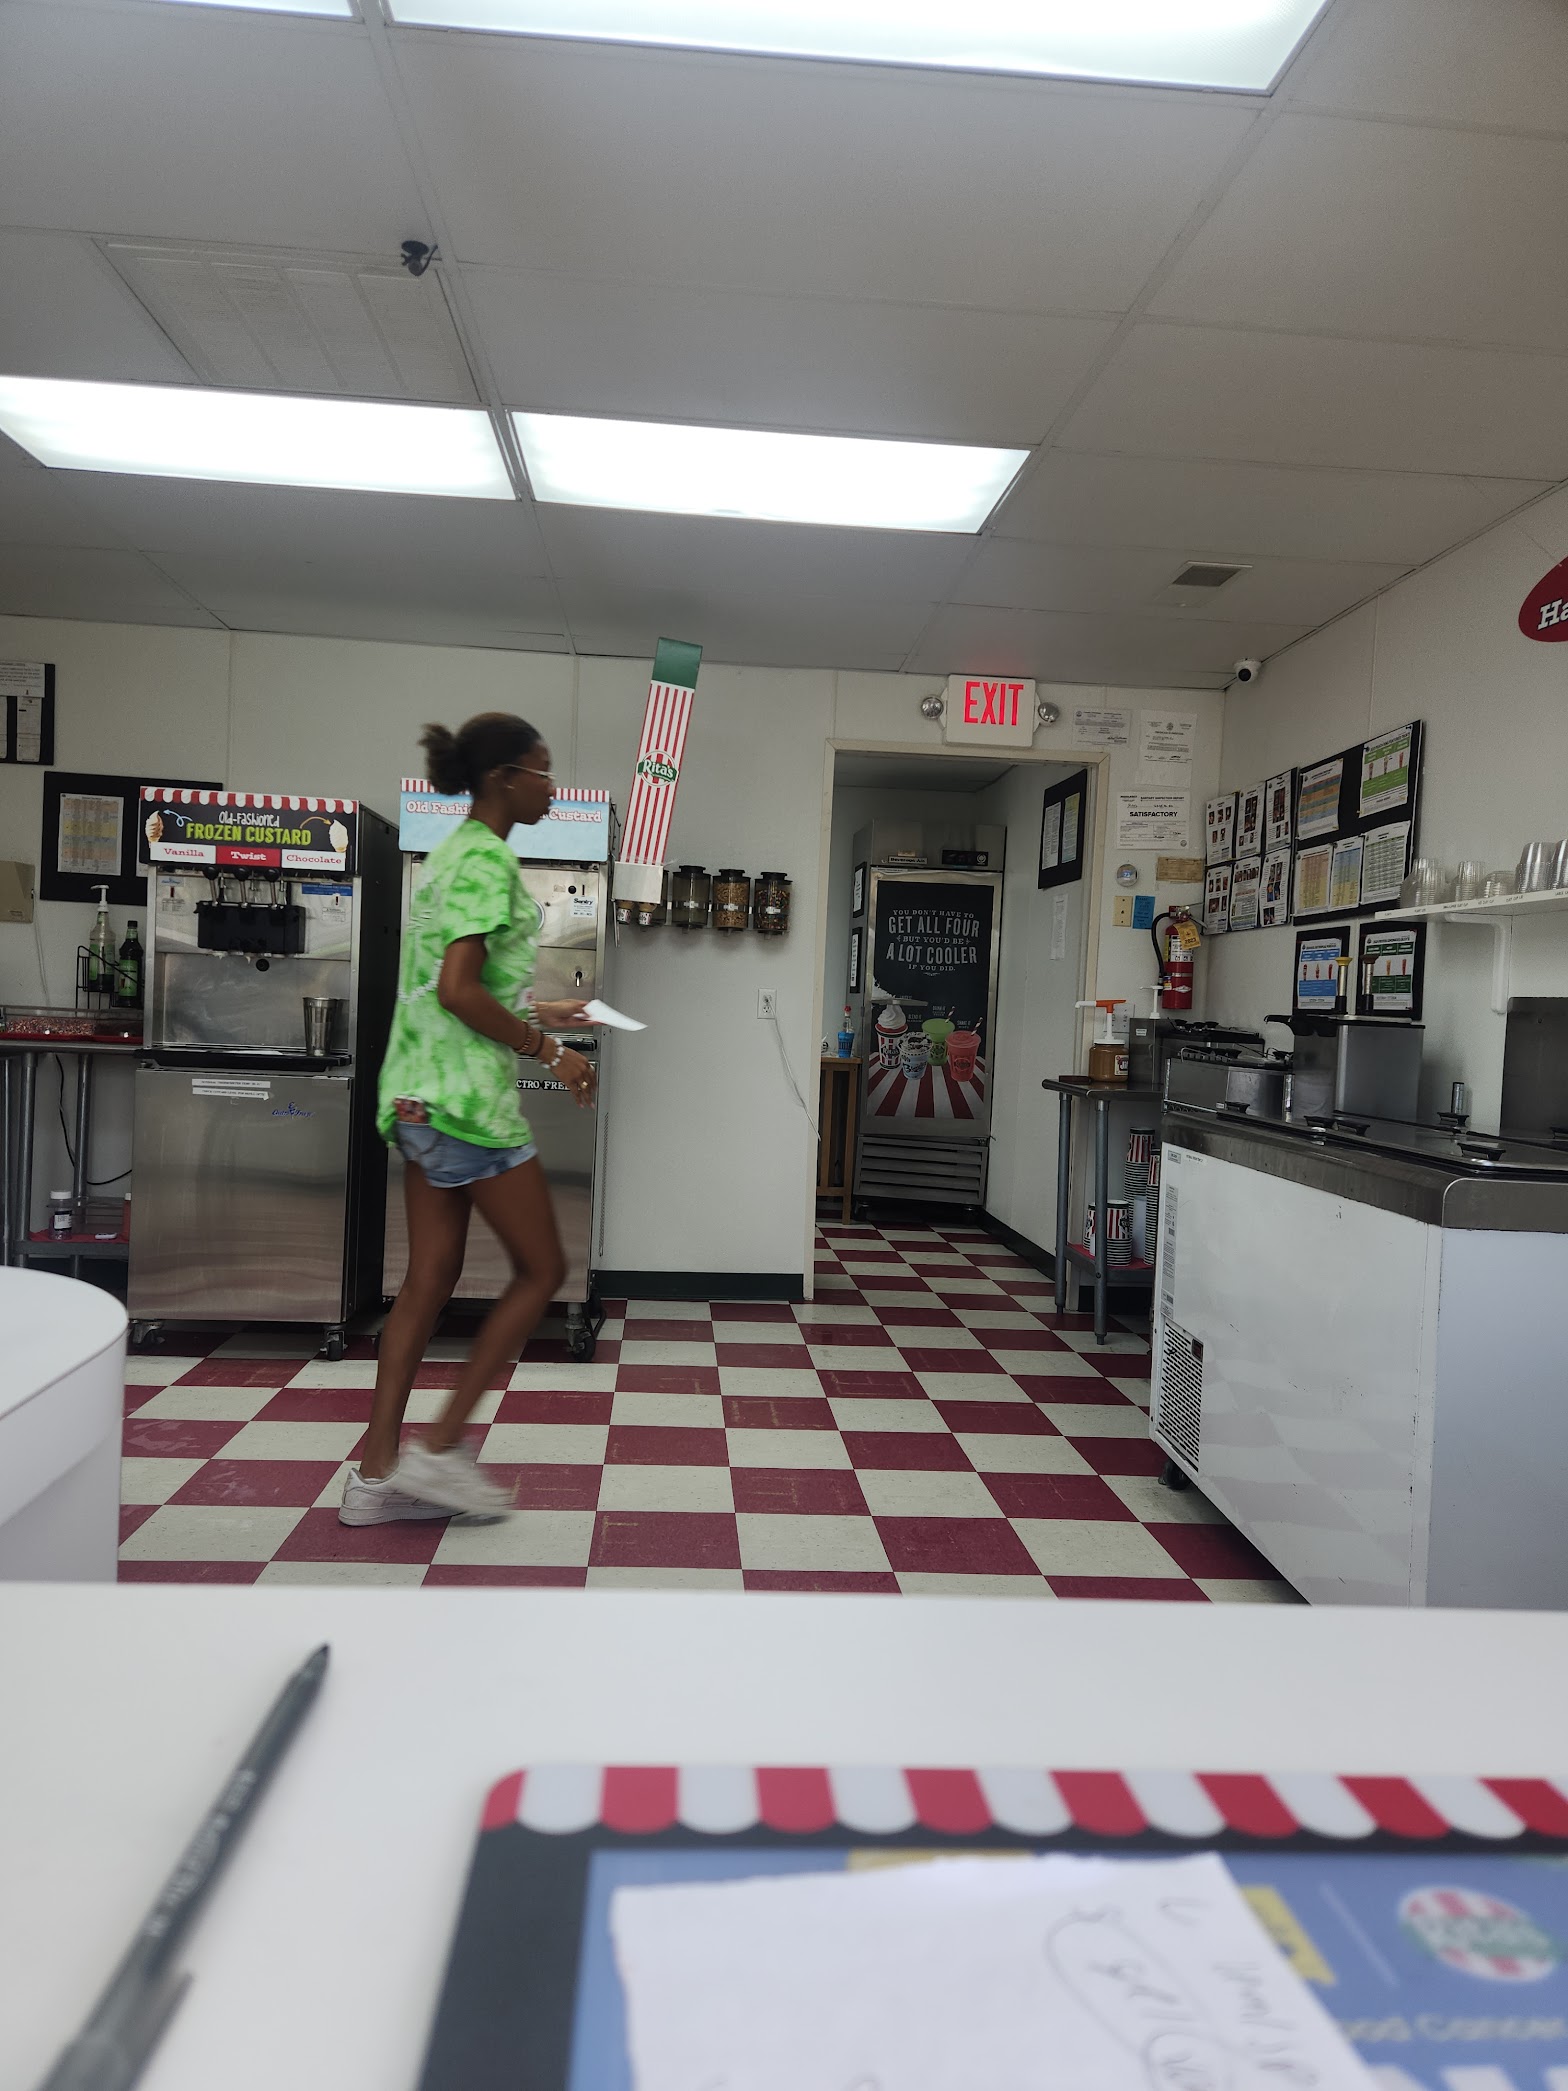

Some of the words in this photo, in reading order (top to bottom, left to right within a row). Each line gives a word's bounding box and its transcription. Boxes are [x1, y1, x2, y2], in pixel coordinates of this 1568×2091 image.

[963, 681, 1024, 726] EXIT
[643, 758, 674, 778] Rita's
[406, 801, 429, 814] Old
[219, 811, 280, 828] Old-Fashioned
[549, 808, 602, 823] Custard
[186, 823, 242, 841] FROZEN
[245, 826, 312, 845] CUSTARD
[163, 848, 205, 857] Vanilla
[230, 851, 267, 861] Twist
[286, 854, 342, 864] Chocolate
[888, 916, 912, 934] GET
[917, 916, 940, 934] ALL
[945, 917, 980, 938] FOUR
[923, 936, 950, 944] YOU'D
[886, 942, 895, 960] A
[898, 943, 923, 963] LOT
[926, 946, 977, 964] COOLER
[516, 1080, 540, 1089] CTRO
[544, 1081, 571, 1090] FRE
